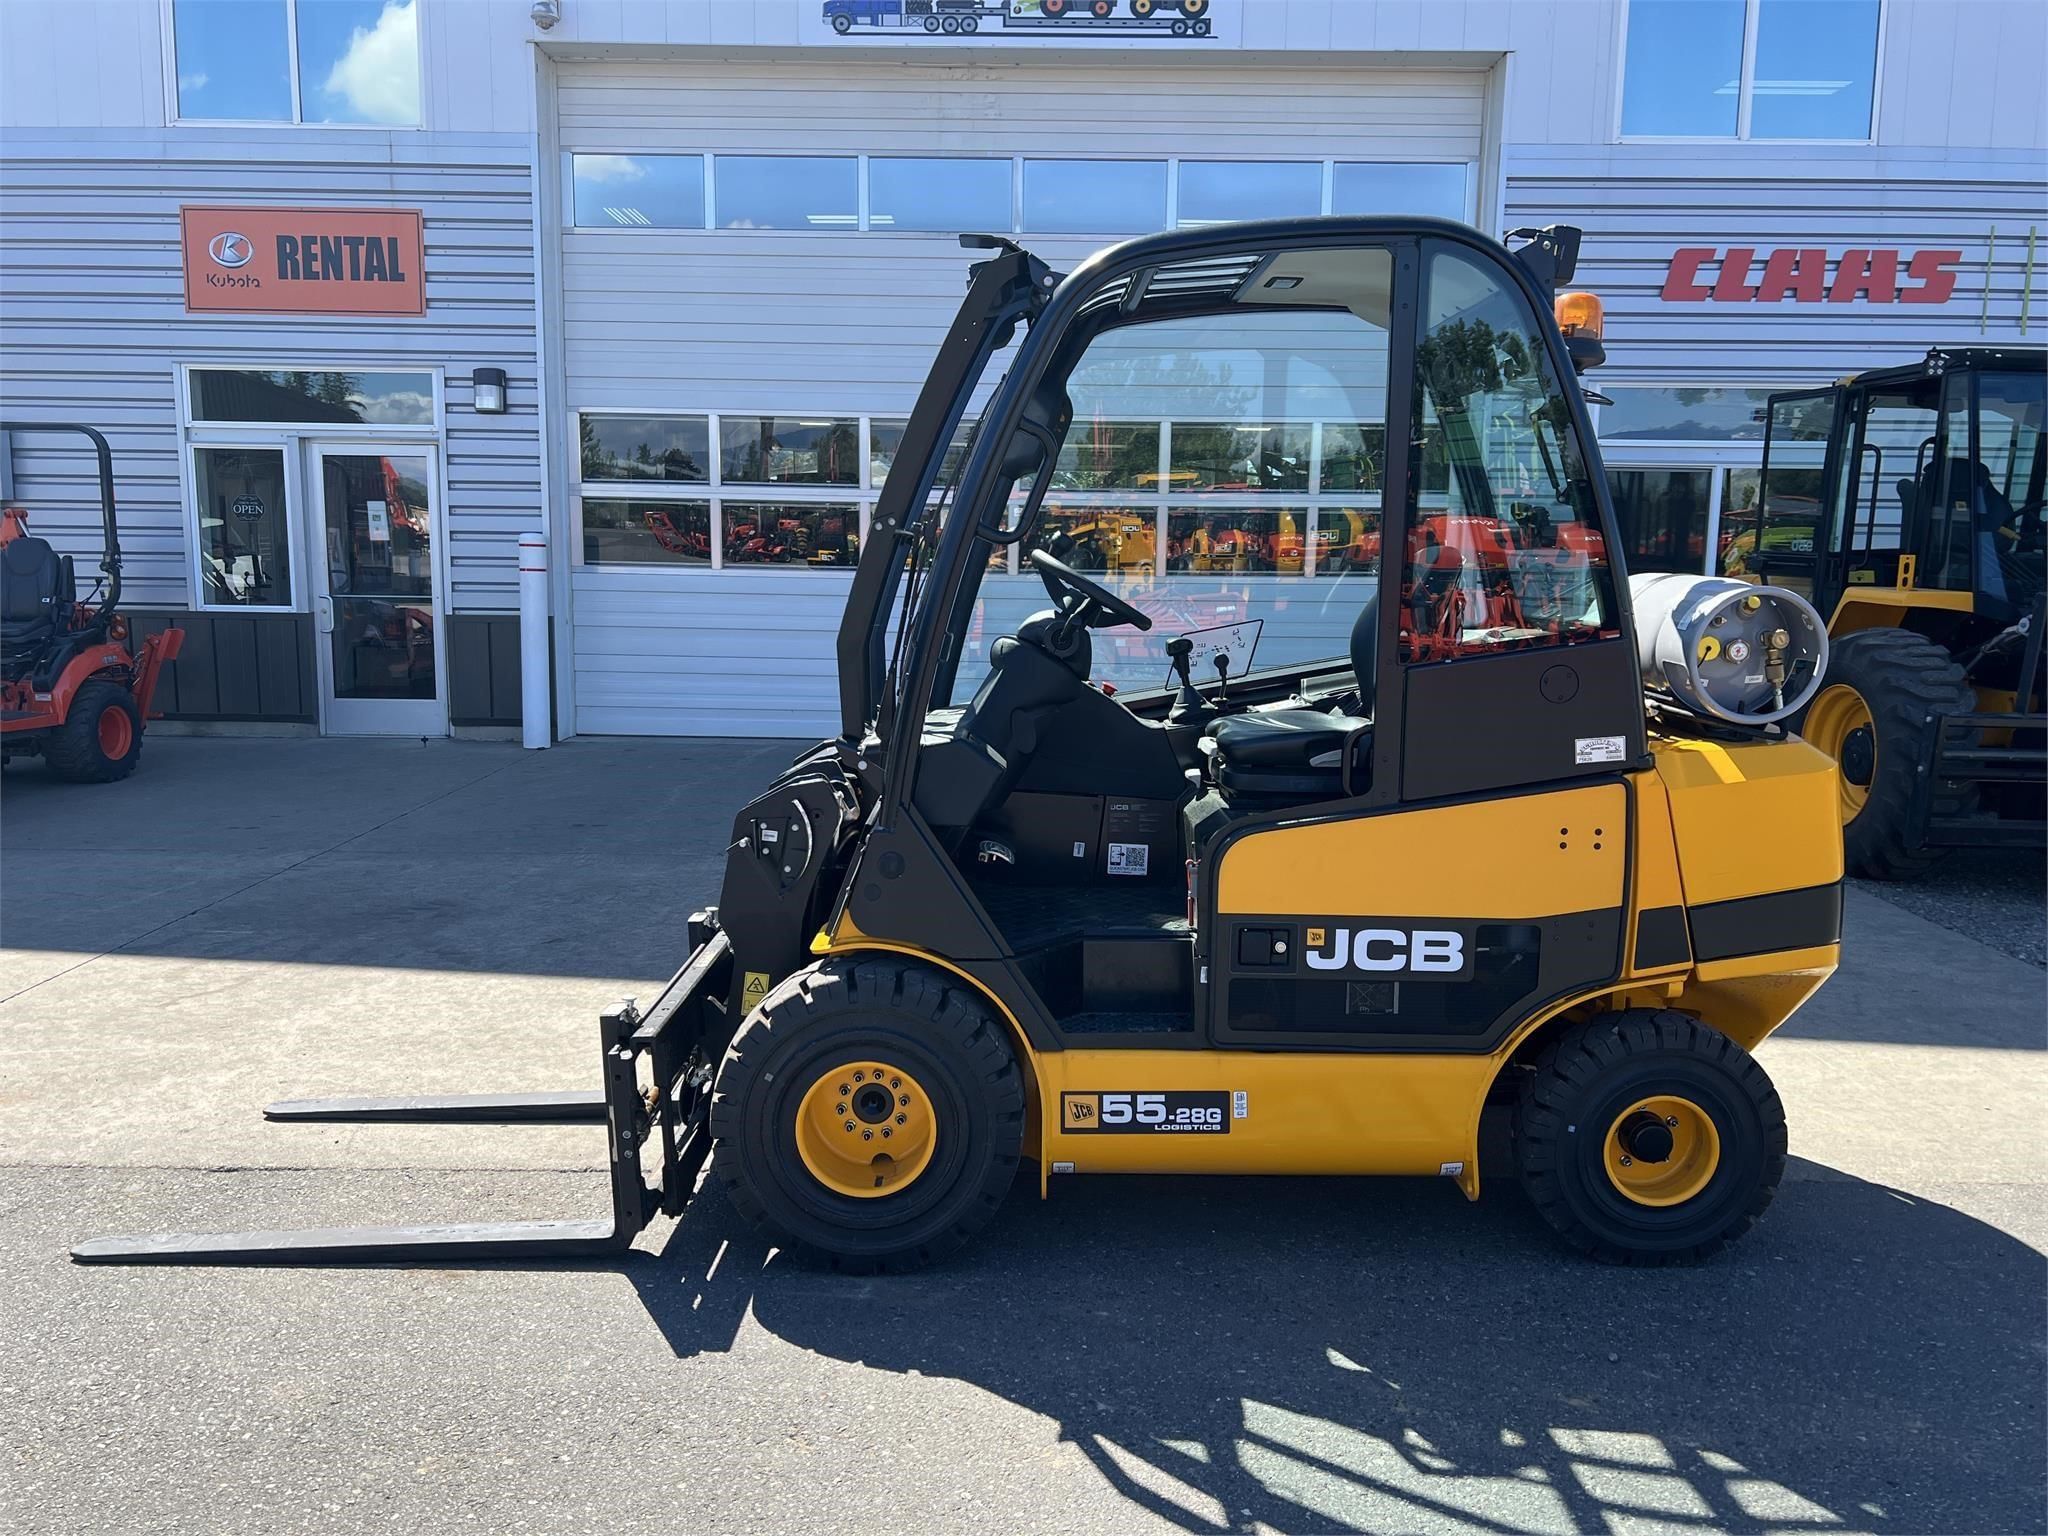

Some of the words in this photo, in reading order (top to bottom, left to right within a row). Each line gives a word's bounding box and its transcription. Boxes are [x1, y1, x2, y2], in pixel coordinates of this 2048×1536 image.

[276, 235, 405, 282] RENTAL
[206, 273, 261, 288] Kubota
[1660, 248, 1963, 304] CLAAS
[233, 504, 264, 514] OPEN
[1306, 928, 1464, 972] JCB
[1074, 1103, 1093, 1119] JCB
